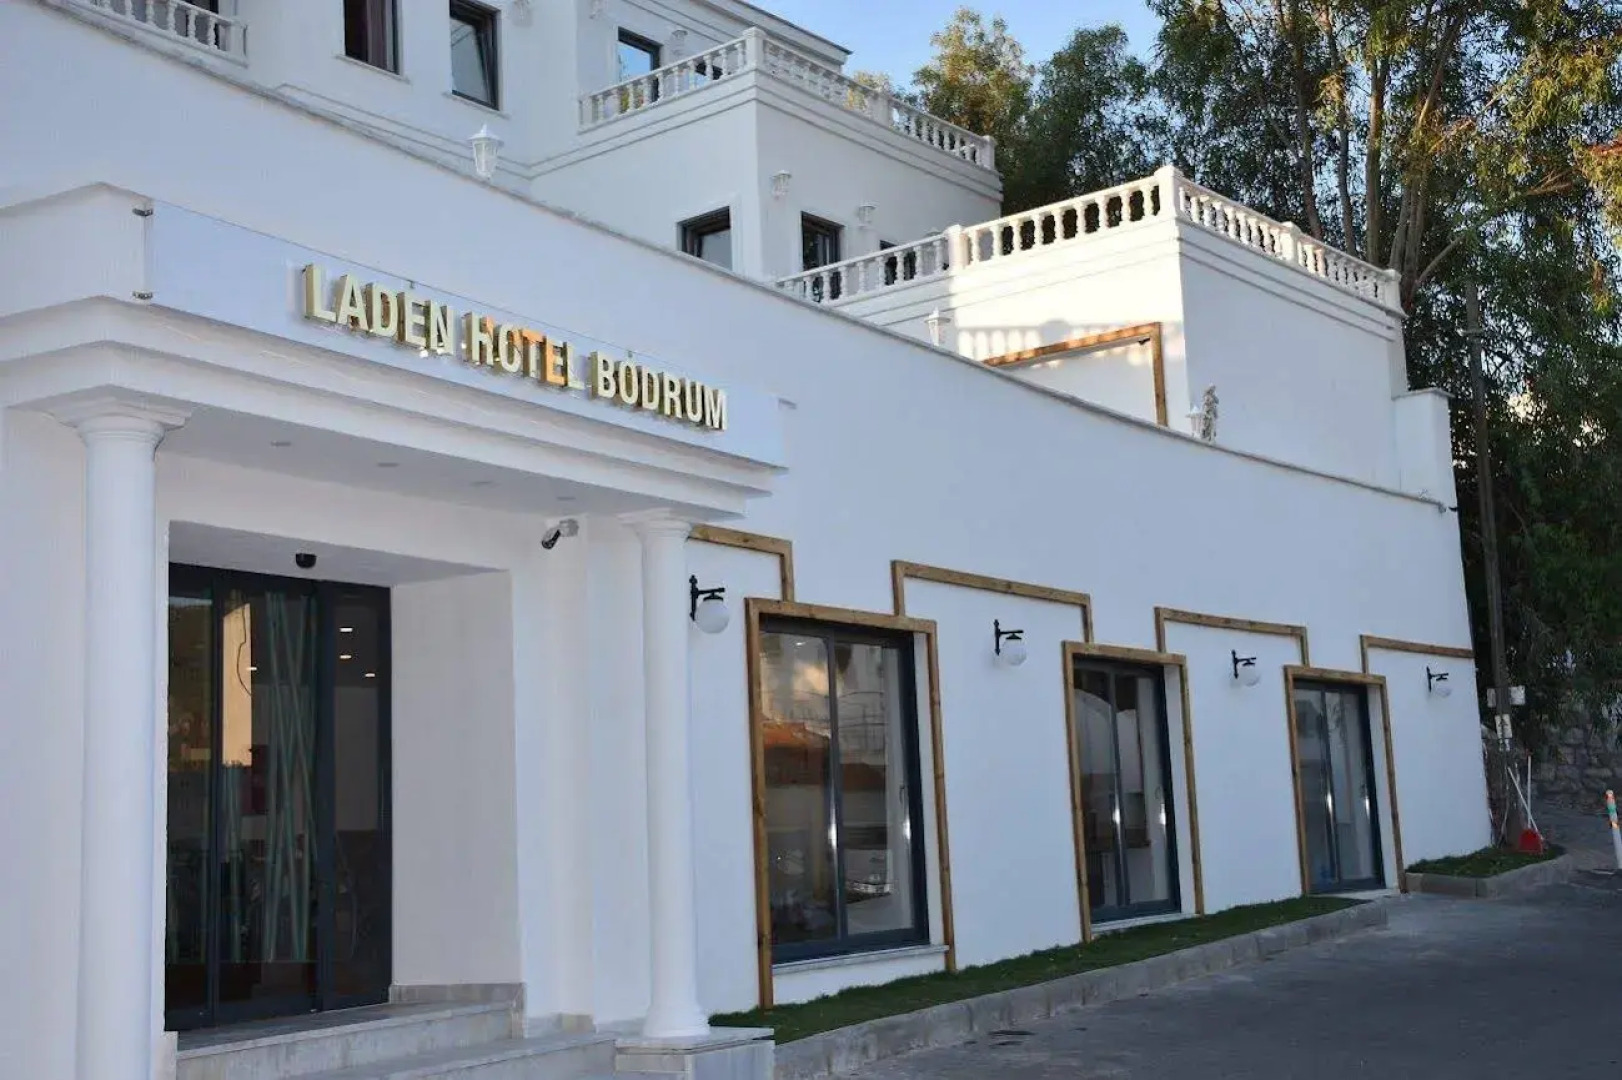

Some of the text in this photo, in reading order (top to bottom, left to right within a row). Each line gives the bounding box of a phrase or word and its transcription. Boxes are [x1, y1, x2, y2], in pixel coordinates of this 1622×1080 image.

[304, 264, 727, 430] LADEN HOTEL BODRUM
